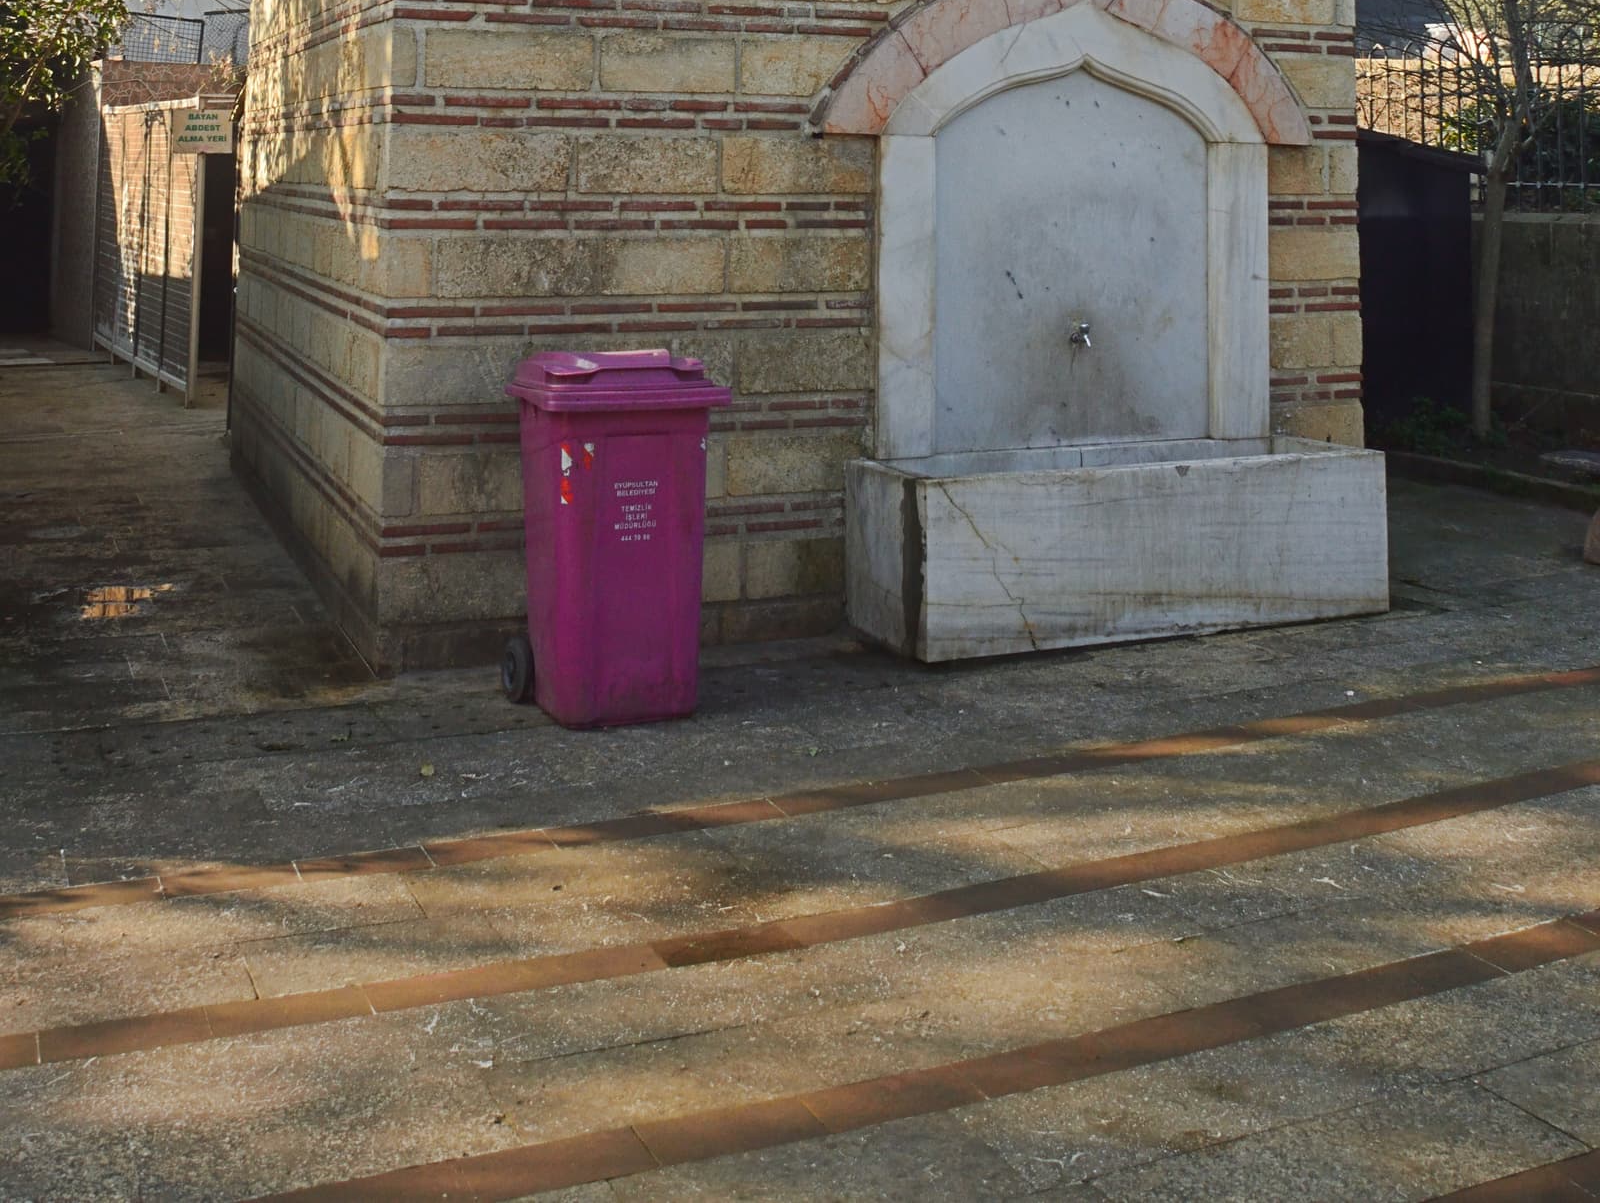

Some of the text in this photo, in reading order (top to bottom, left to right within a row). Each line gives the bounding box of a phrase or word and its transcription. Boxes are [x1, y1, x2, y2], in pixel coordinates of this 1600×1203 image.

[207, 133, 227, 142] YERİ
[614, 480, 658, 489] EYÜPSULTAN
[616, 488, 656, 497] BELEDİYESİ
